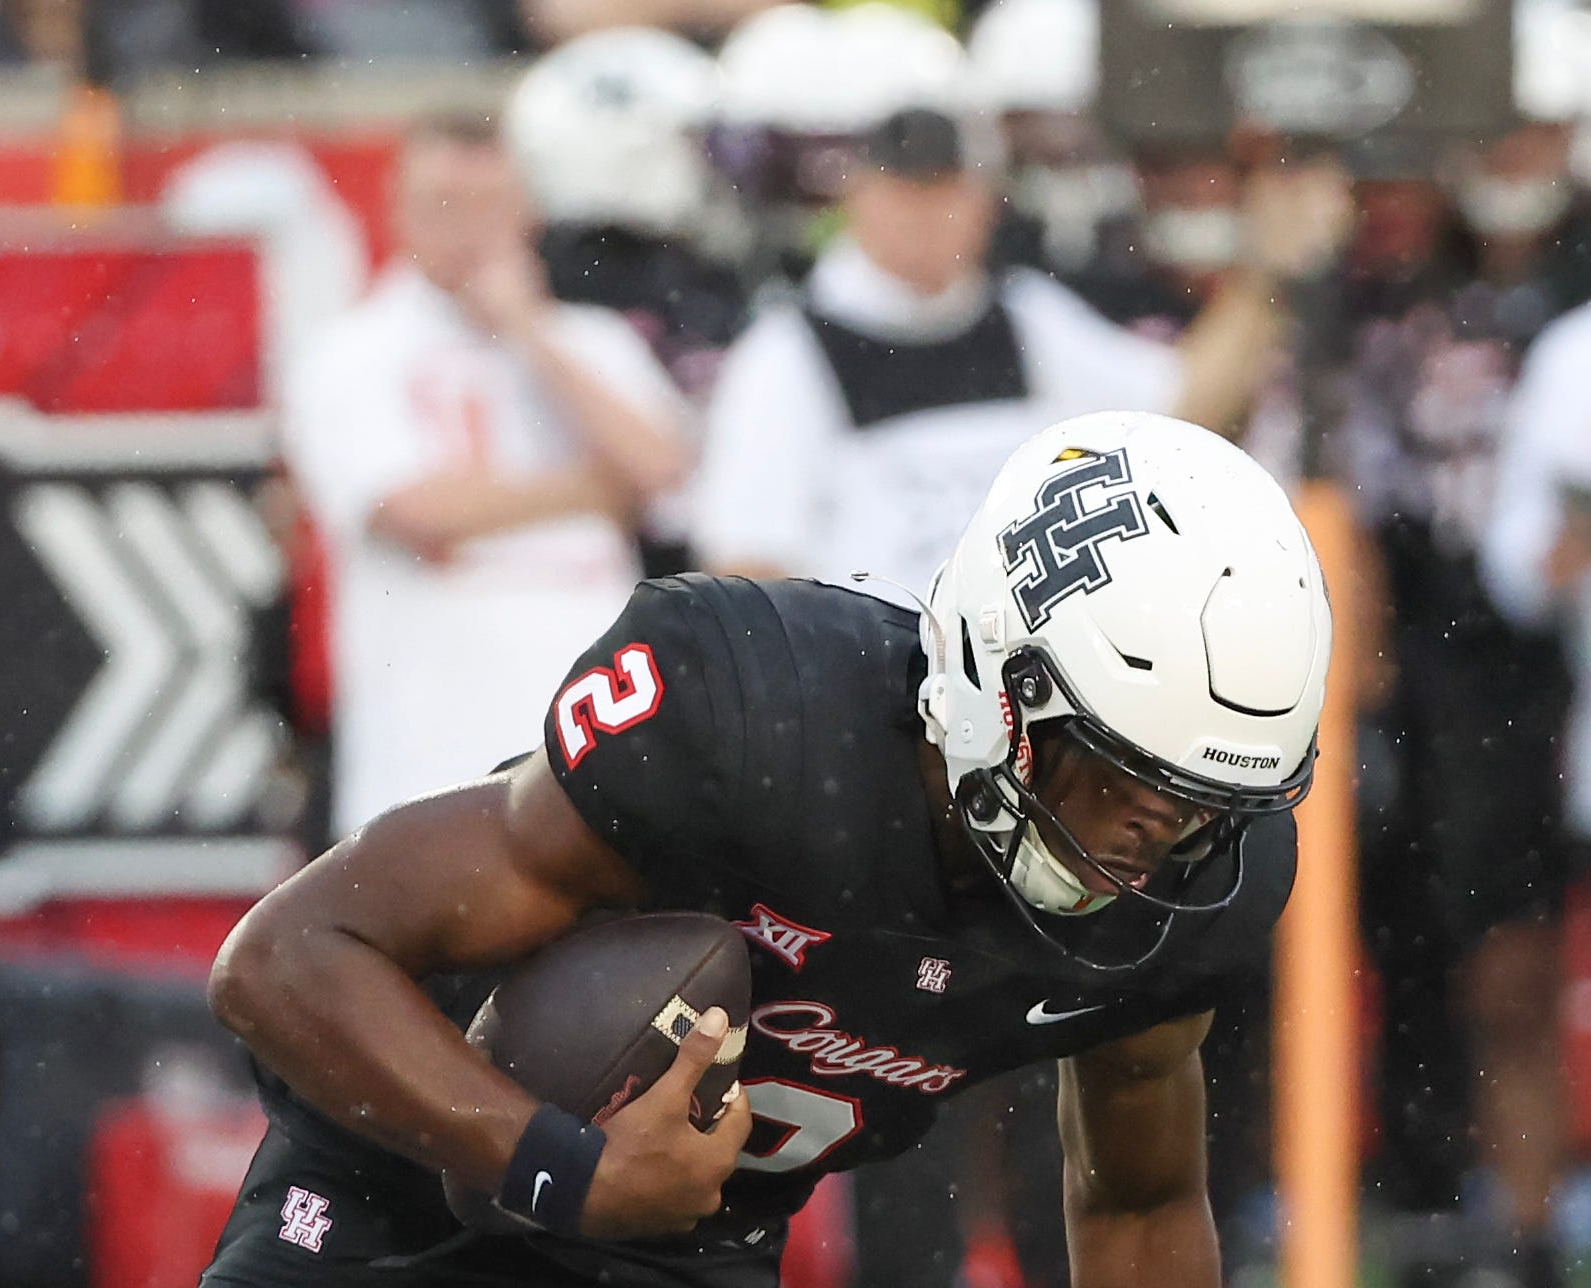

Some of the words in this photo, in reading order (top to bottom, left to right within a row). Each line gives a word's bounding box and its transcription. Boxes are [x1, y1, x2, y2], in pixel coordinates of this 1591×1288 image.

[553, 642, 666, 772] 2
[1202, 747, 1281, 769] HOUSTON
[751, 1000, 968, 1094] Cougars
